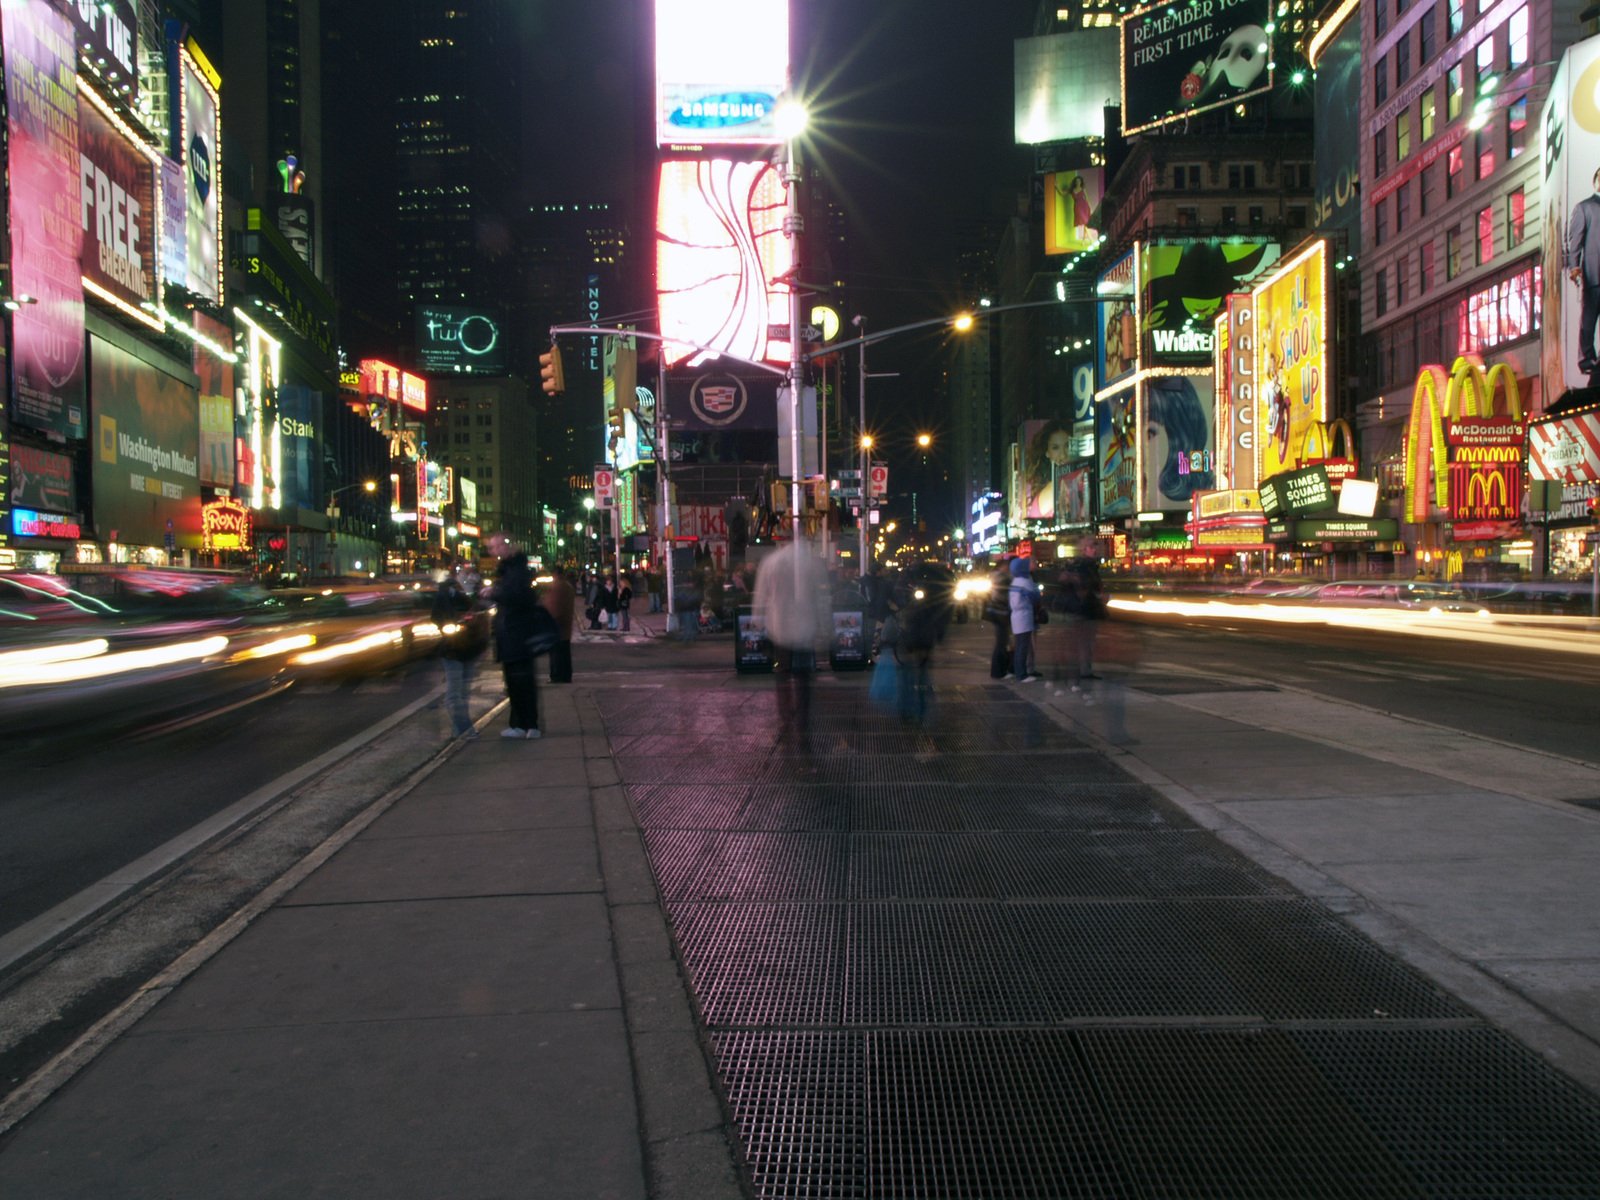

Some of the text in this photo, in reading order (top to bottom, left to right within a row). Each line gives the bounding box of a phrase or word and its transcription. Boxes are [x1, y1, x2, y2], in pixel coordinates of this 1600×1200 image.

[105, 8, 133, 75] THE
[1134, 1, 1213, 45] REMEMBER
[1134, 39, 1173, 67] FIRST
[681, 102, 764, 117] SAMSUNG
[80, 152, 142, 271] FREE
[99, 240, 150, 300] CHECKING
[1290, 274, 1308, 326] ALL
[42, 327, 66, 365] OUT
[800, 330, 817, 338] WAY
[1280, 311, 1319, 370] SHOOK
[1239, 308, 1252, 449] PALACE
[1302, 361, 1319, 412] UP
[1451, 425, 1522, 436] McDonald's
[119, 432, 197, 477] Washington Mutual
[1287, 473, 1320, 489] TIMES
[1287, 482, 1326, 500] SQUARE
[1561, 485, 1596, 501] MERAS
[1292, 493, 1326, 508] ALLIANCE
[1345, 523, 1368, 531] SQUARE
